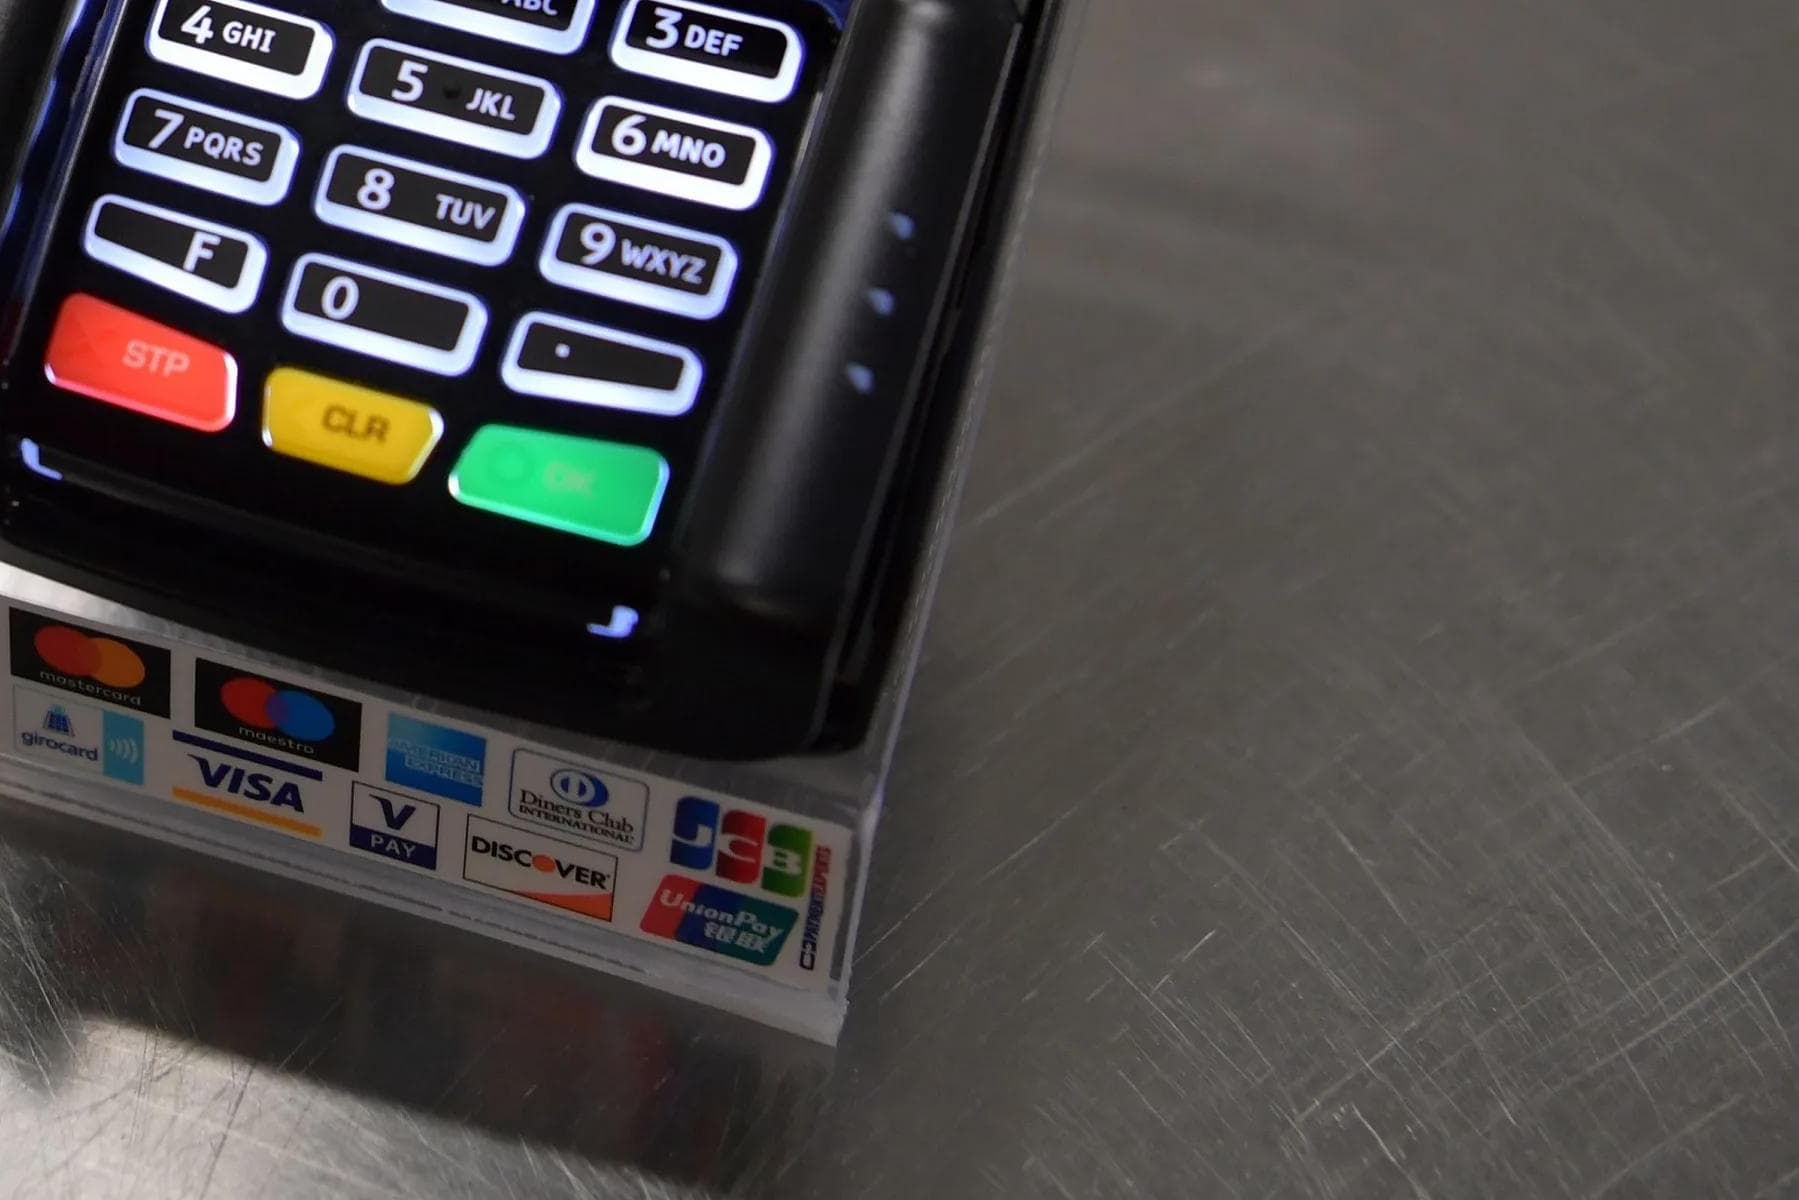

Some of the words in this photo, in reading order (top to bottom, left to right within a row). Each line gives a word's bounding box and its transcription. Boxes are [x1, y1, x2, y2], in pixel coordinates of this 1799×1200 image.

[180, 5, 214, 46] 4
[222, 23, 275, 55] GHI
[645, 7, 679, 48] 3
[683, 23, 744, 57] DEF
[391, 60, 428, 103] 5
[466, 86, 517, 122] JKL
[148, 108, 183, 150] 7
[183, 127, 264, 168] PQRS
[610, 113, 646, 156] 6
[650, 130, 726, 169] MNO
[356, 167, 393, 211] 8
[435, 192, 497, 231] TUV
[182, 230, 222, 273] F
[579, 223, 616, 266] 9
[618, 243, 708, 284] WXYZ
[320, 277, 360, 322] 0
[121, 340, 191, 380] STP
[321, 403, 391, 445] CLR
[39, 670, 142, 707] mastercard
[20, 729, 99, 763] girocard
[238, 726, 316, 755] maestro
[388, 736, 481, 773] AMERICAN
[187, 753, 306, 814] VISA
[367, 794, 417, 831] V
[518, 804, 635, 845] INTERNATIONAL
[519, 788, 584, 820] Diners
[587, 803, 635, 834] Club
[370, 831, 417, 861] PAY
[470, 834, 608, 890] DISCOVER
[671, 798, 806, 886] JCB
[658, 888, 784, 942] UnionPay
